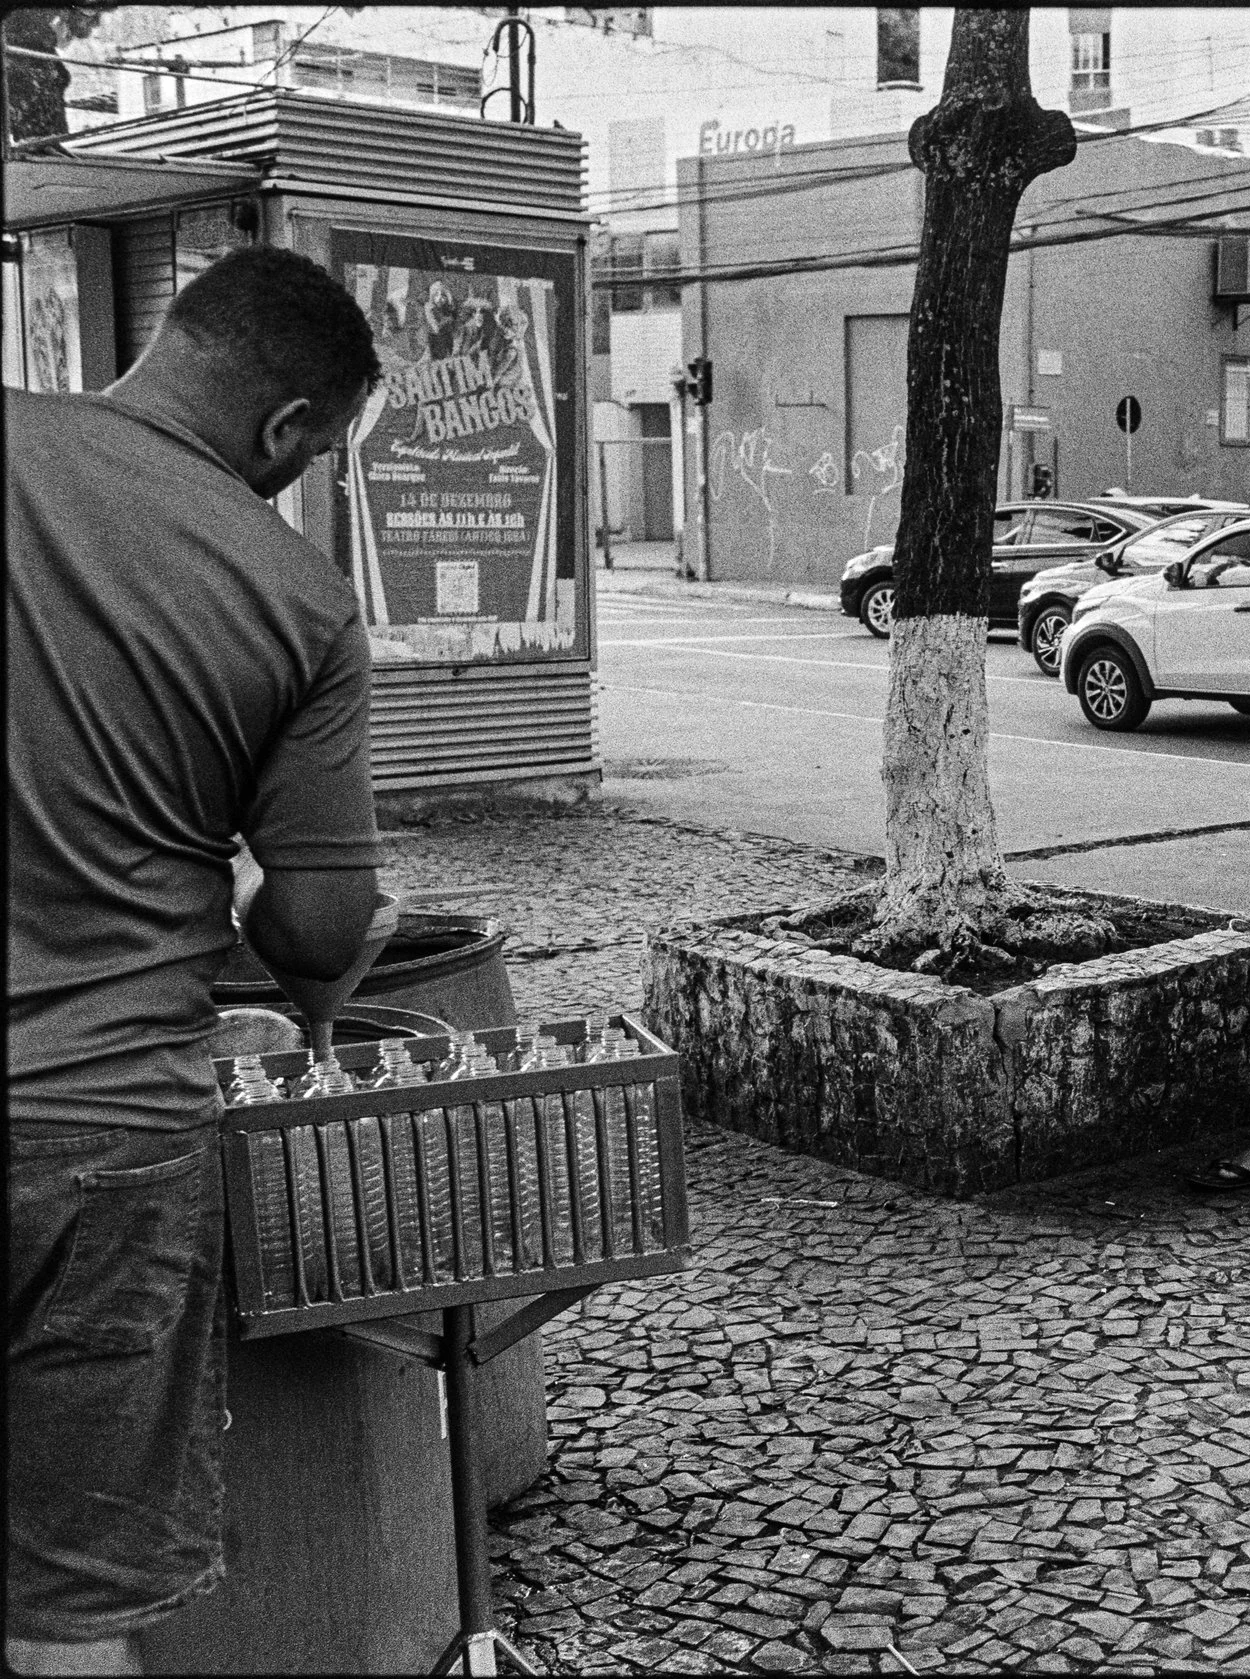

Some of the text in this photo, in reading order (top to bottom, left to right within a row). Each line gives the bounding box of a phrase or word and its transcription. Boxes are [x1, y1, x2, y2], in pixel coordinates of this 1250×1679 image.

[699, 123, 796, 154] Europa
[386, 350, 494, 409] SALTIM
[422, 384, 535, 443] BANCOS
[400, 492, 512, 508] 14 DE DEZEMBRO
[386, 509, 437, 526] SESSÕES
[380, 530, 421, 542] TEATRO
